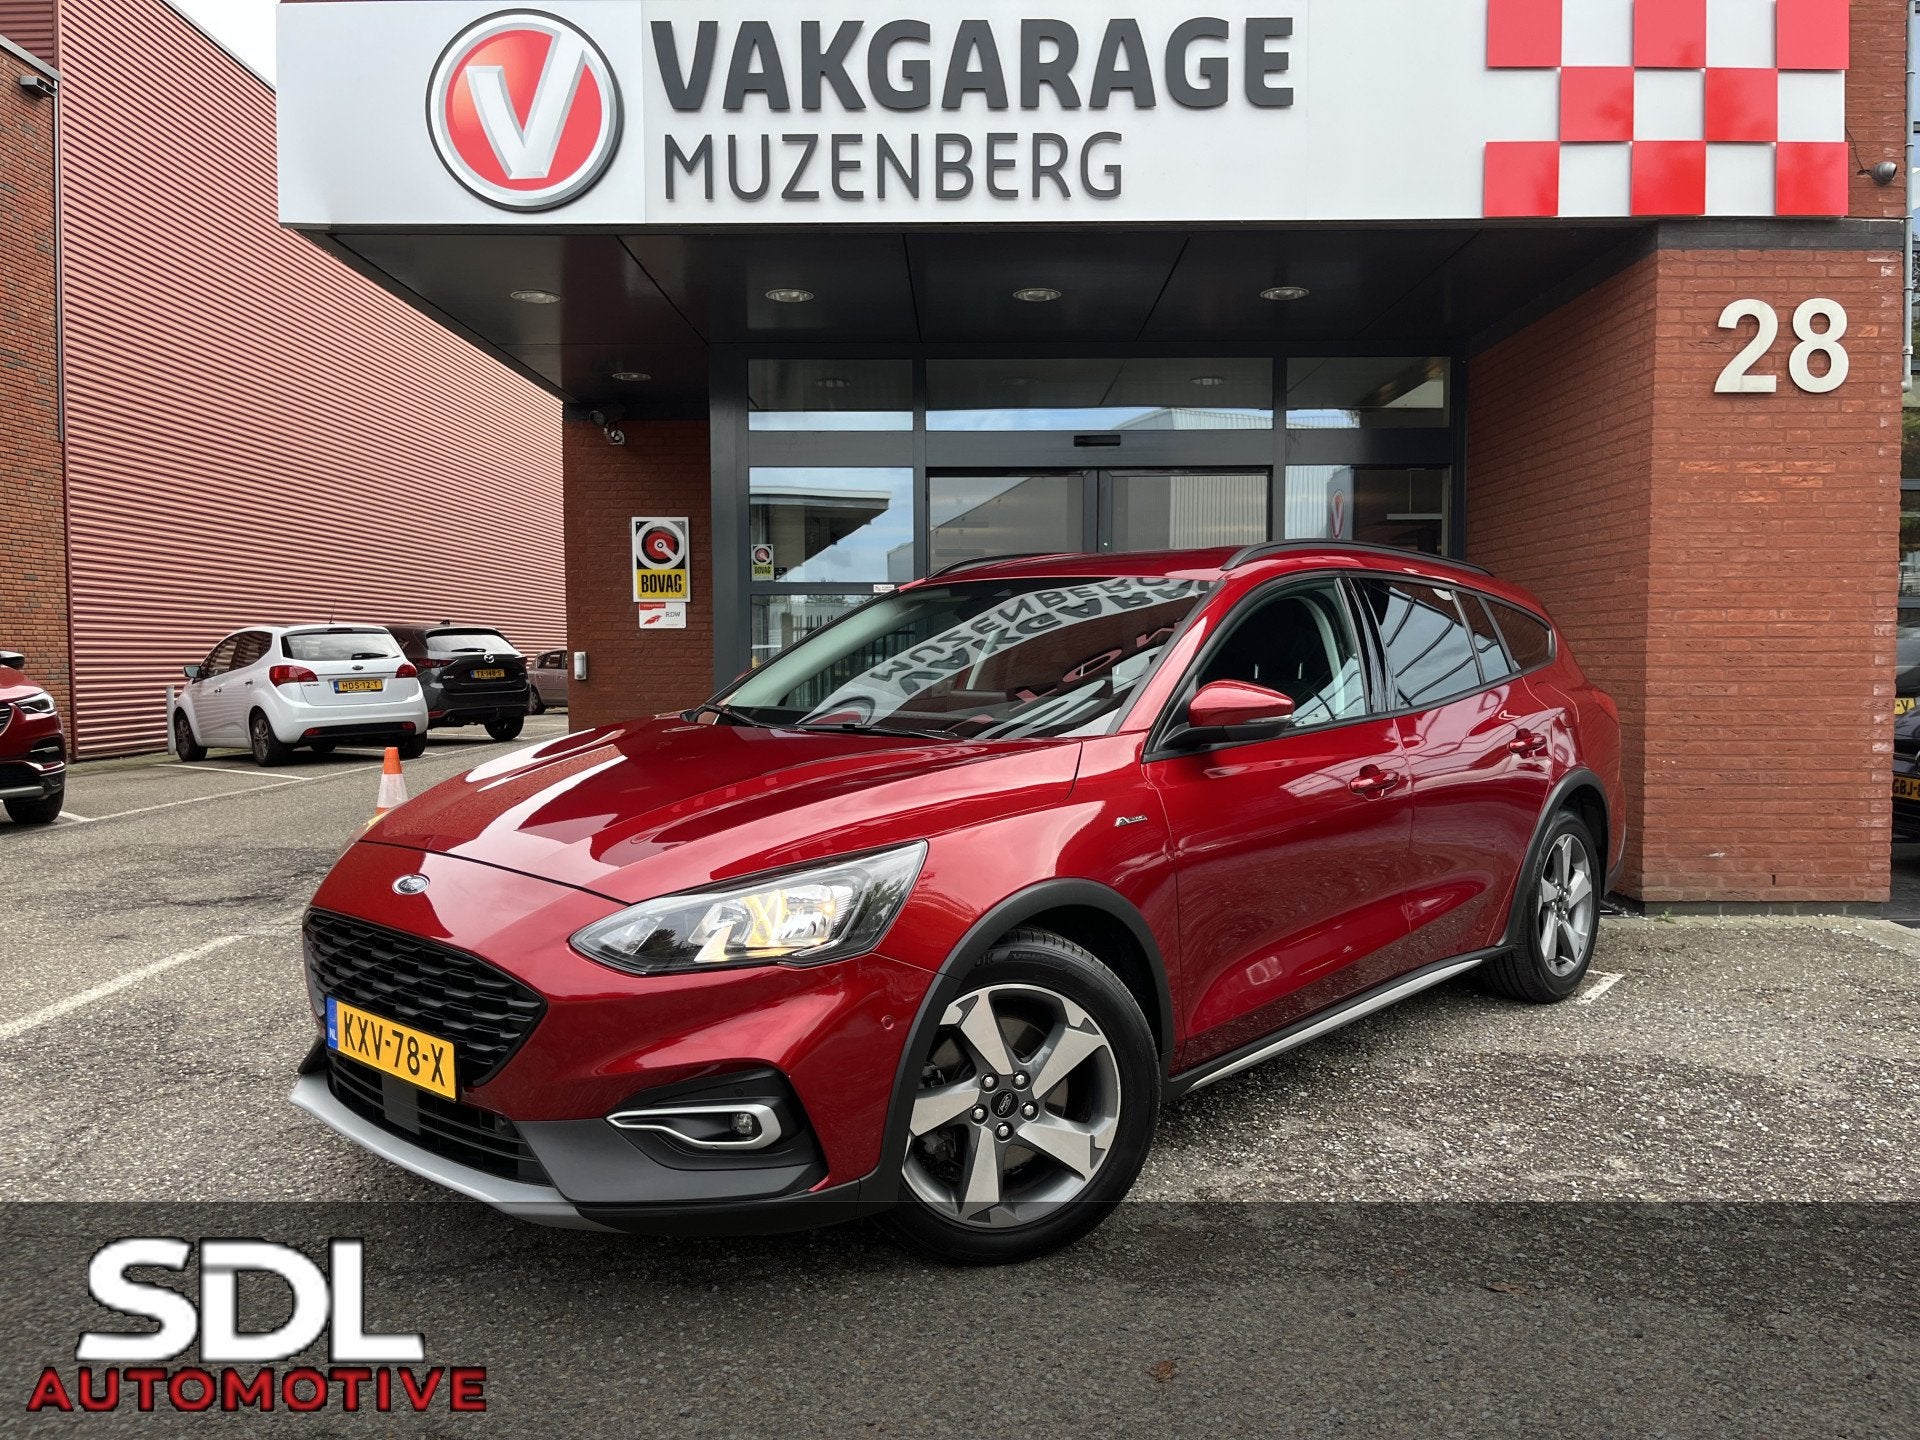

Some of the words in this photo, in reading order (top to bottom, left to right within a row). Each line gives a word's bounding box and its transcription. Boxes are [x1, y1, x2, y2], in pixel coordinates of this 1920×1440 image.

[650, 16, 1294, 112] VAKGARAGE
[664, 130, 1123, 201] MUZENBERG
[1714, 298, 1850, 393] 28
[641, 574, 682, 593] BOVAG
[754, 566, 771, 575] BOVAG
[342, 680, 379, 690] HDS-12-T
[328, 1026, 338, 1042] NL
[343, 1010, 446, 1088] KXV-78-X
